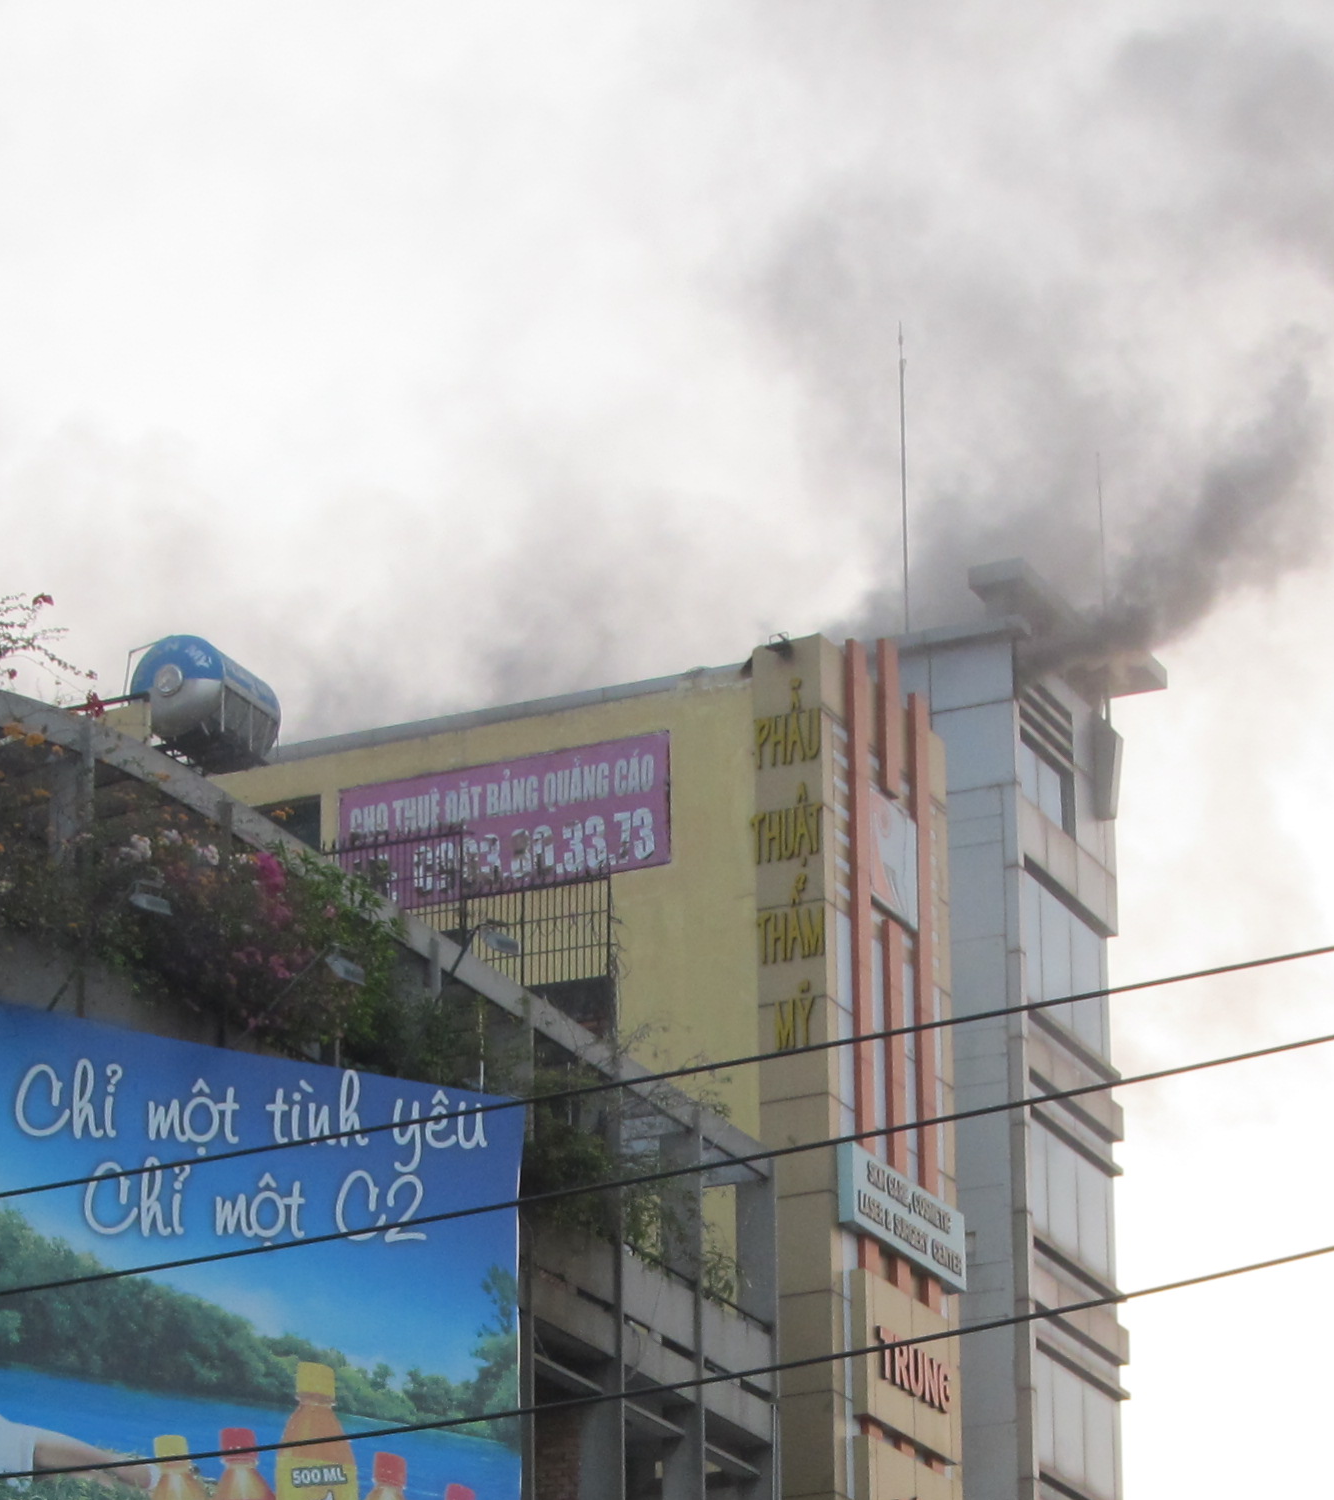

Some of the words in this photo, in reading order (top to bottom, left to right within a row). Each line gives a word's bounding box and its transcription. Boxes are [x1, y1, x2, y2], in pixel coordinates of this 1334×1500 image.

[350, 803, 388, 845] CHO
[393, 789, 440, 833] THUÊ
[486, 769, 538, 817] BẢNG
[544, 757, 609, 812] QUẢNG
[614, 751, 655, 795] CÁO
[751, 781, 823, 867] THUẬT
[757, 873, 826, 965] THẨM
[774, 978, 816, 1050] MỸ
[15, 1058, 122, 1139] Chỉ
[148, 1079, 239, 1155] một
[267, 1069, 369, 1146] tình
[392, 1090, 488, 1173] yêu
[83, 1158, 191, 1238] Chỉ
[215, 1172, 305, 1251] một
[335, 1170, 427, 1243] C2
[875, 1326, 951, 1413] TRUNG
[292, 1469, 321, 1486] 500
[323, 1466, 346, 1482] ML
